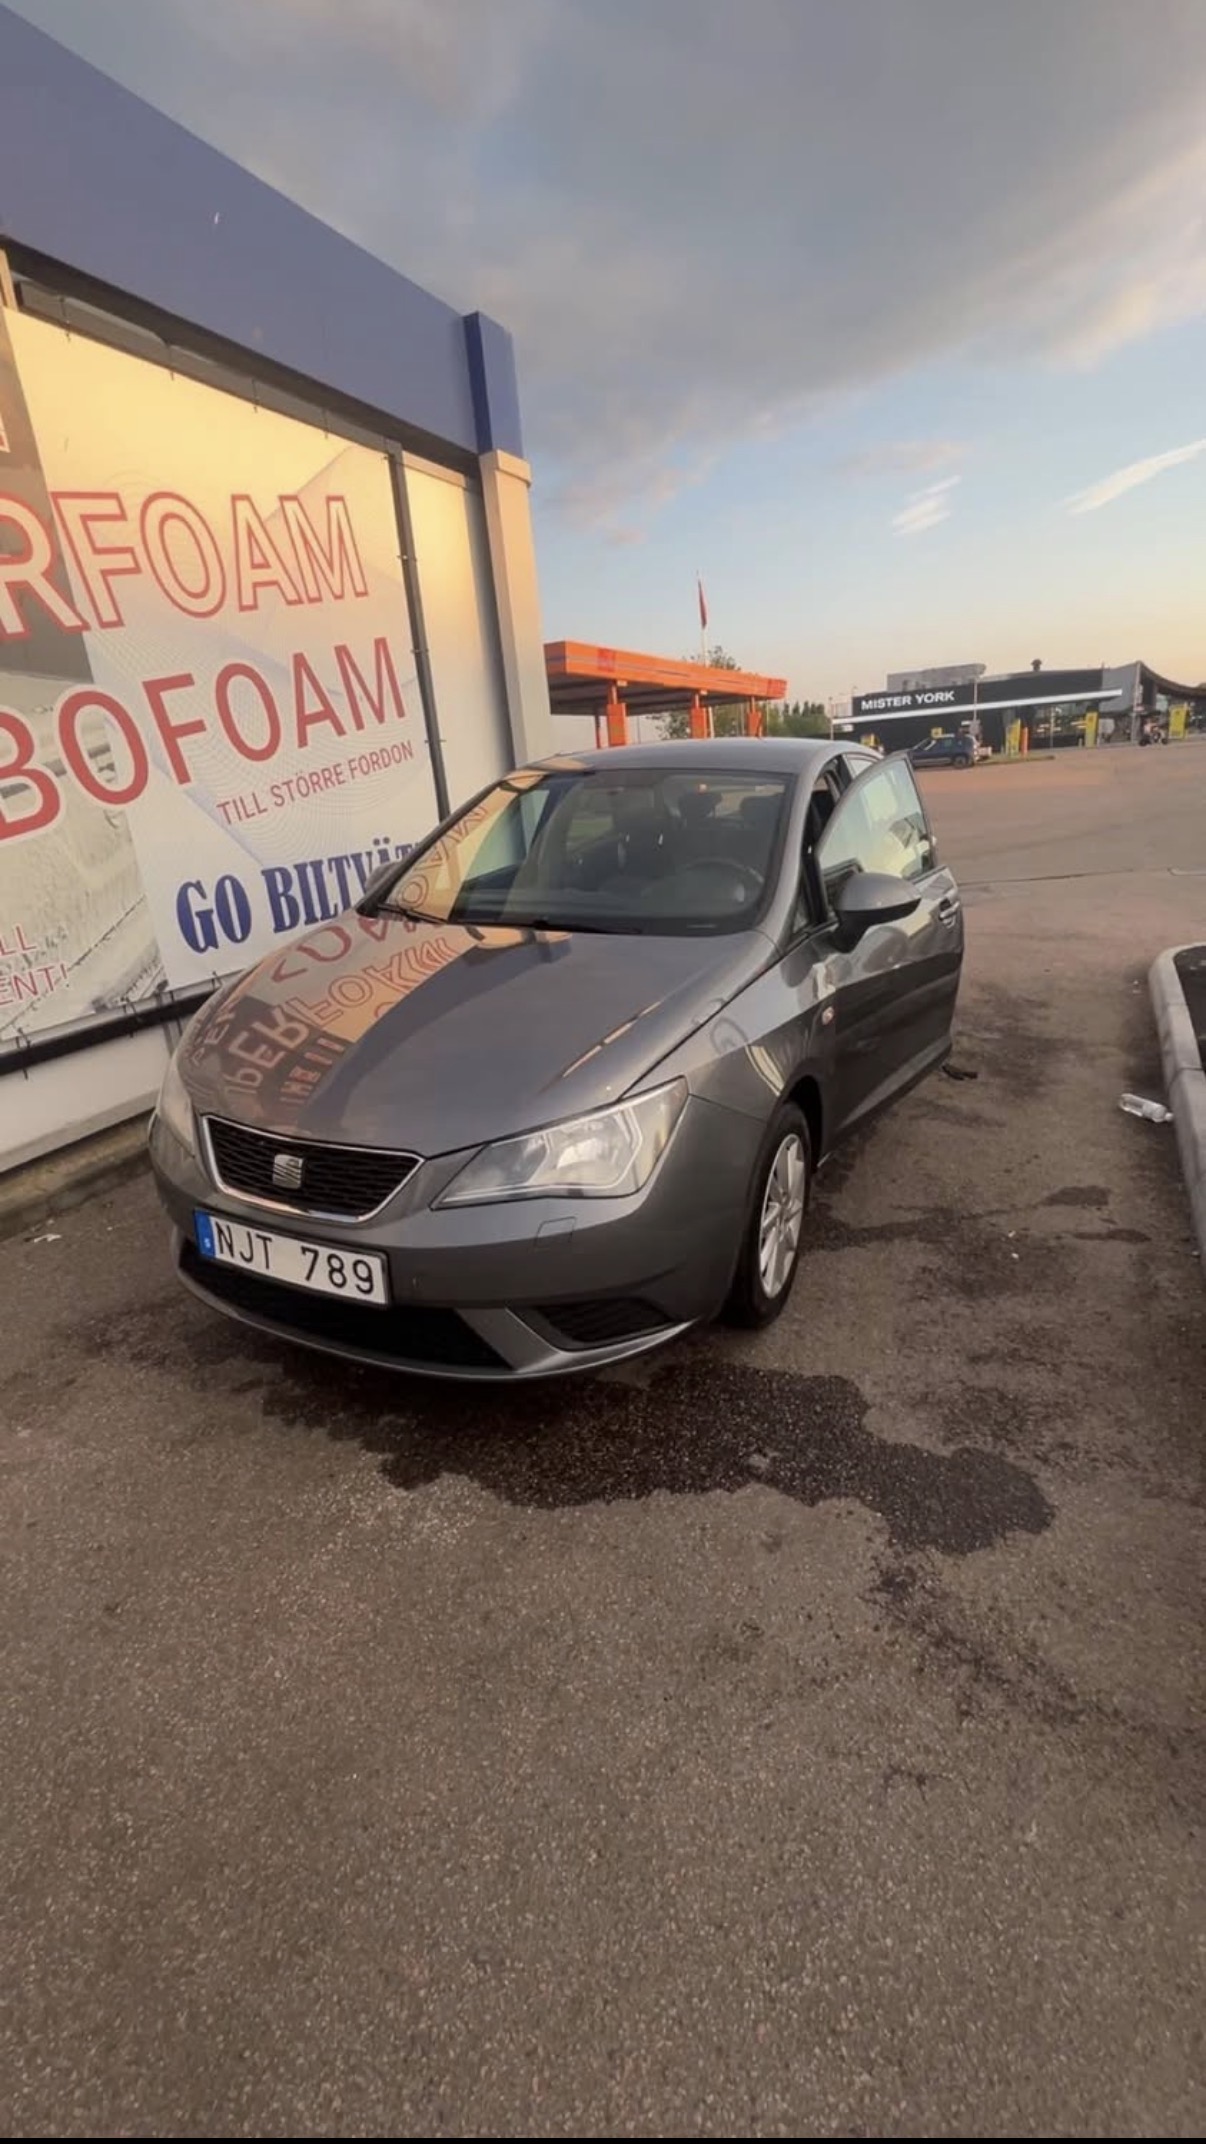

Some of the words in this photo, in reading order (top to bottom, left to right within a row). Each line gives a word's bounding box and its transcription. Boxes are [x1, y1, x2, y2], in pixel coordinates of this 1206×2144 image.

[861, 695, 912, 711] MISTER
[915, 691, 955, 704] YORK
[217, 792, 268, 825] TILL
[270, 763, 346, 807] STÖRRE
[348, 740, 414, 780] FORDON
[176, 874, 252, 954] GO
[261, 837, 419, 934] BILTV
[215, 1221, 273, 1270] NJT
[301, 1246, 374, 1294] 789
